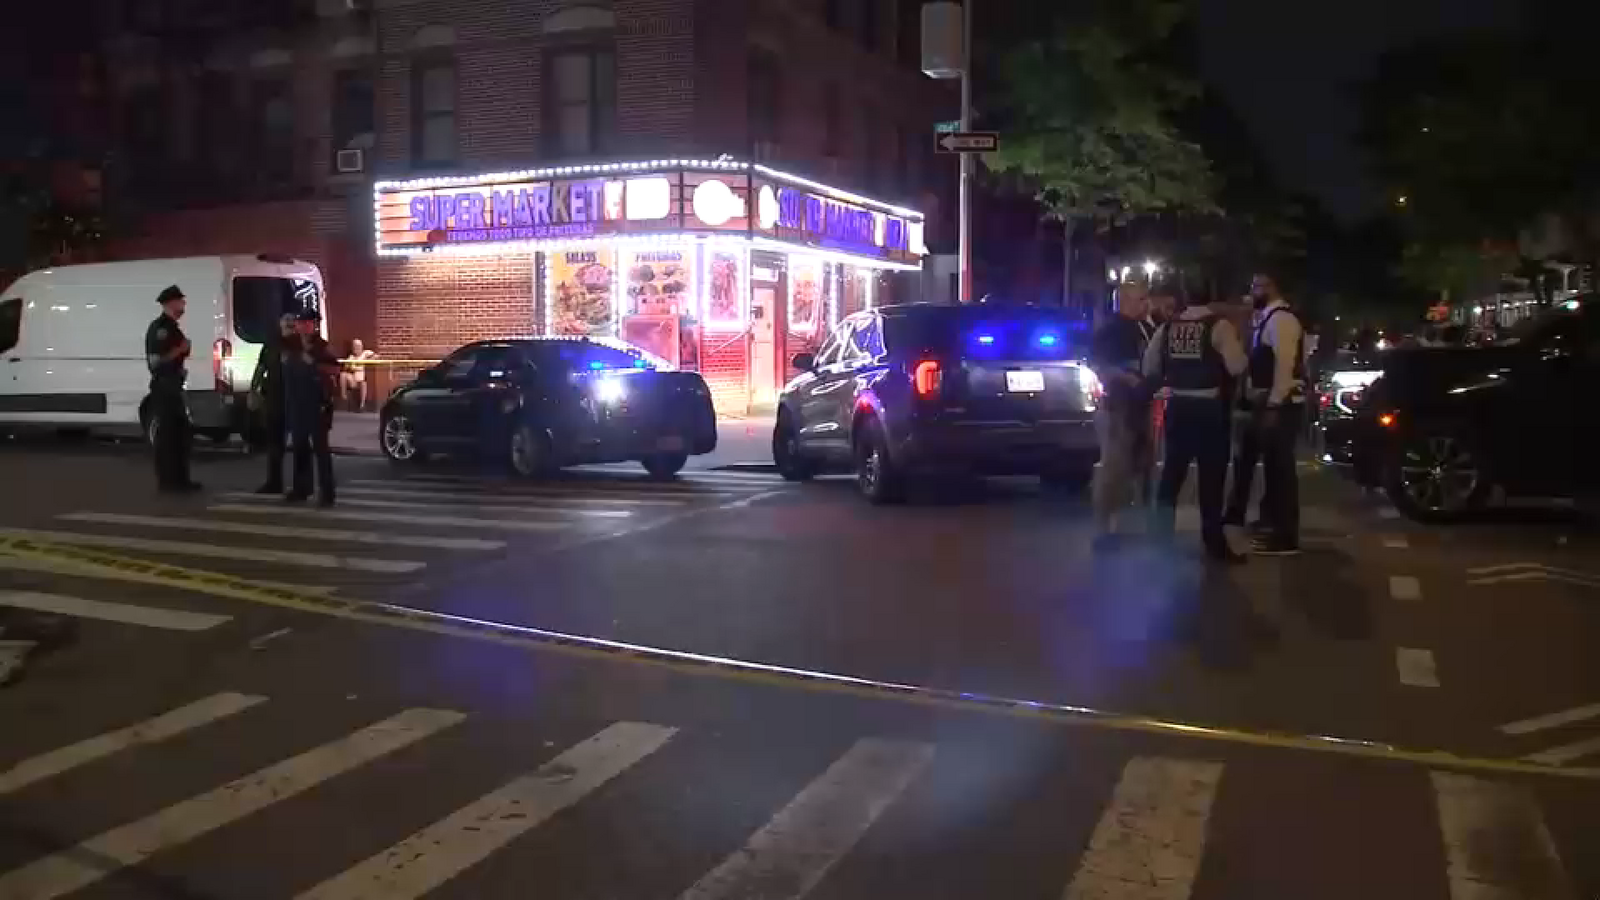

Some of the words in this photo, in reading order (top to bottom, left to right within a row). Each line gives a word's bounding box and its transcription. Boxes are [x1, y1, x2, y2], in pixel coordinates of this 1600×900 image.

[410, 192, 485, 230] SUPER
[492, 179, 604, 226] MARKET
[1172, 324, 1203, 339] NYPD
[1170, 340, 1201, 353] POLICE
